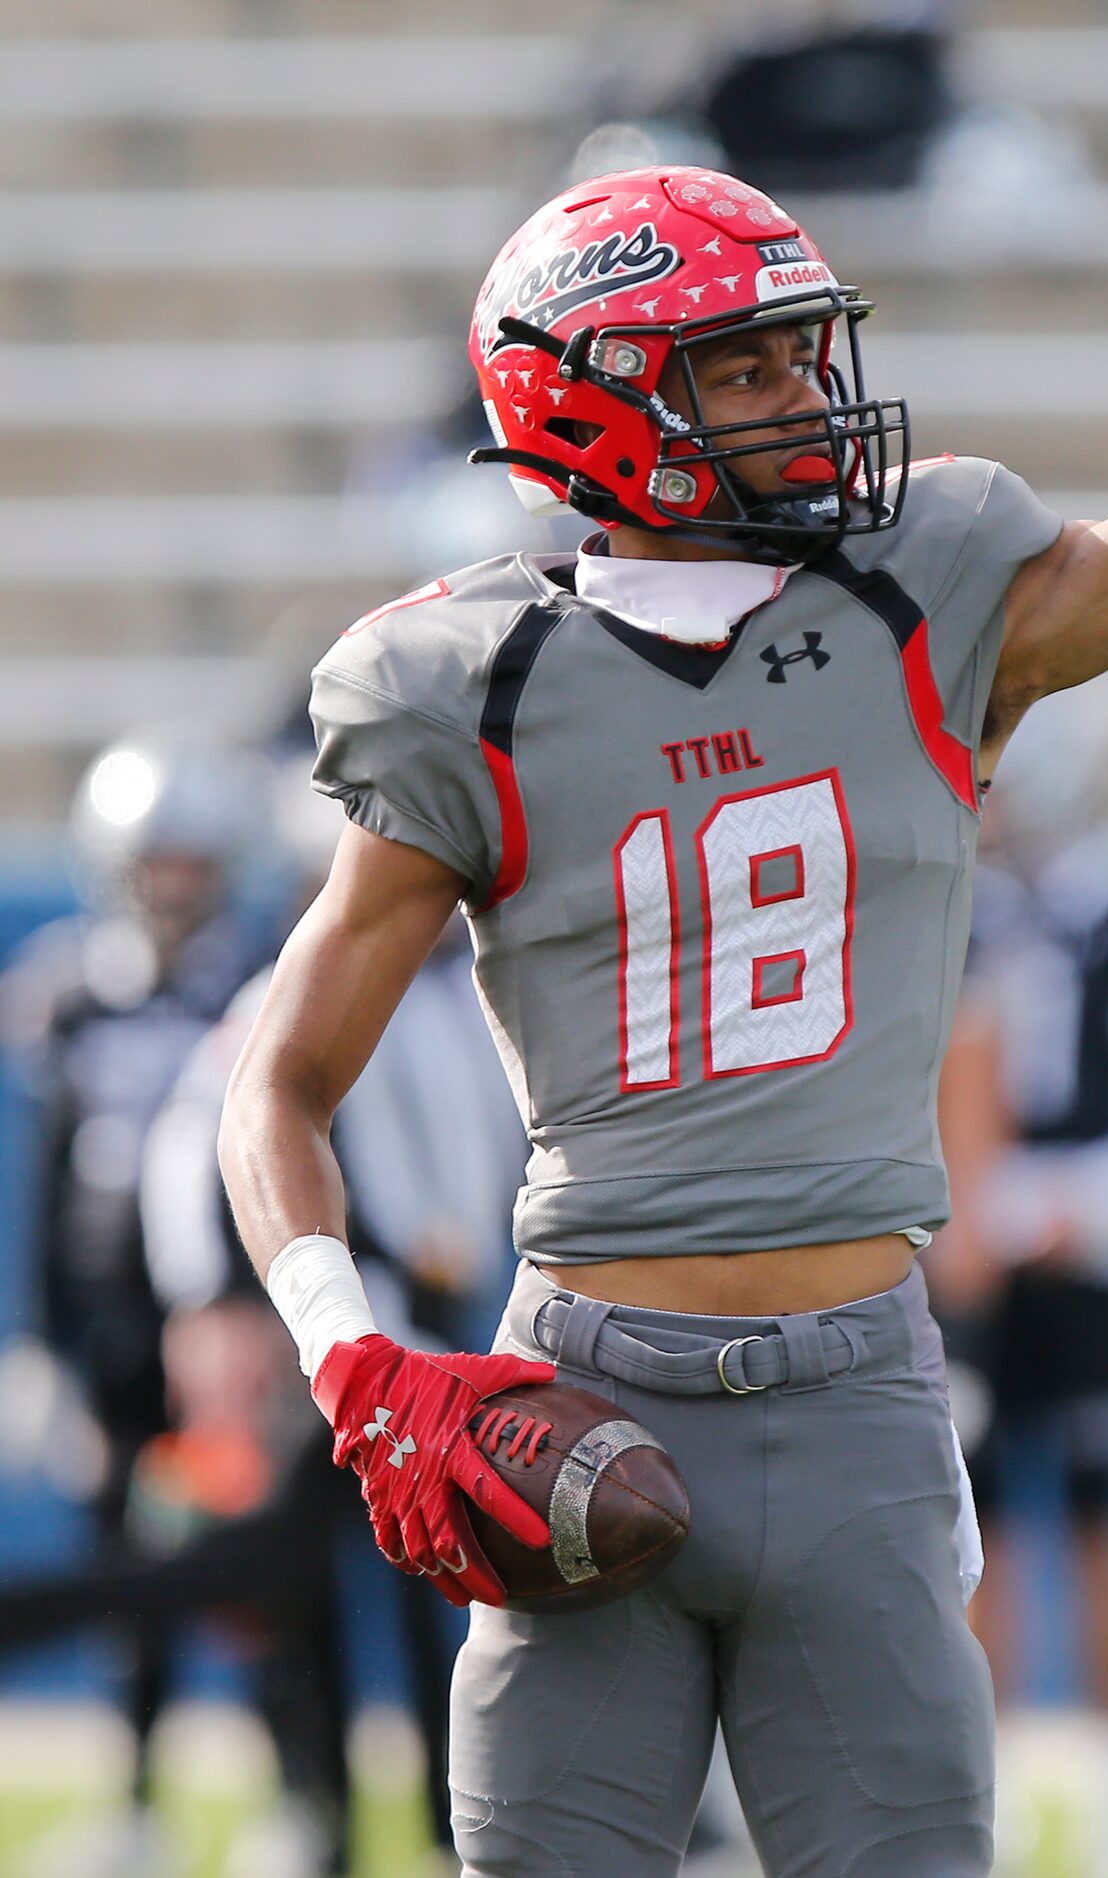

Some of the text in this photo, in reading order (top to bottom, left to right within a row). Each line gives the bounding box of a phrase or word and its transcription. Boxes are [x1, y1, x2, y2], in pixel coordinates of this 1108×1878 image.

[758, 243, 807, 261] TTHL
[768, 265, 831, 288] Riddell
[661, 728, 764, 783] TTHL
[611, 766, 857, 1094] 18
